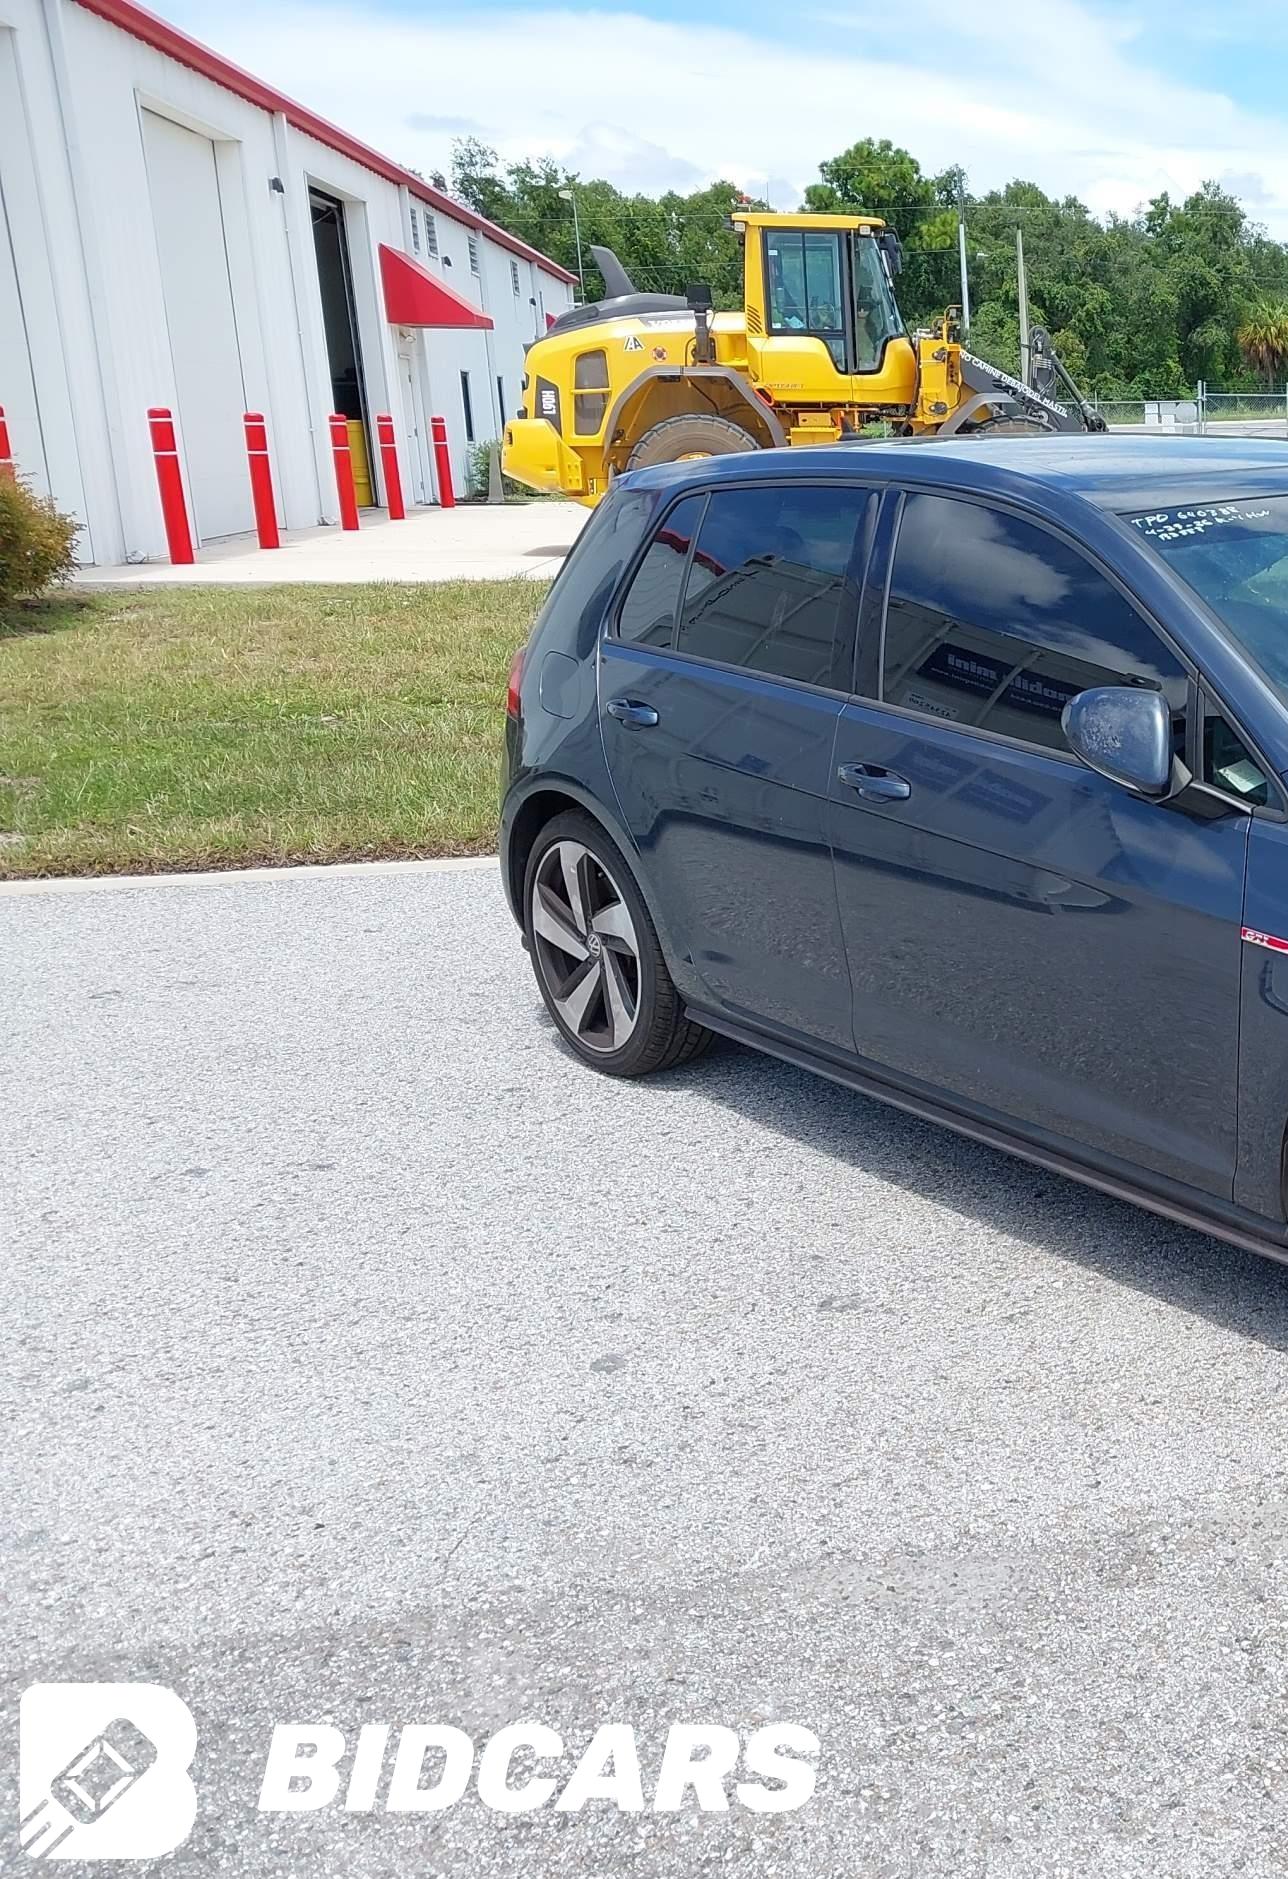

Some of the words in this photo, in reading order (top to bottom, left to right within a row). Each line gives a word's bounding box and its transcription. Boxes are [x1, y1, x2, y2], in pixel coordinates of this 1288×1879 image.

[960, 349, 970, 361] NO
[972, 359, 1001, 379] CAMINE
[541, 390, 556, 415] L90H
